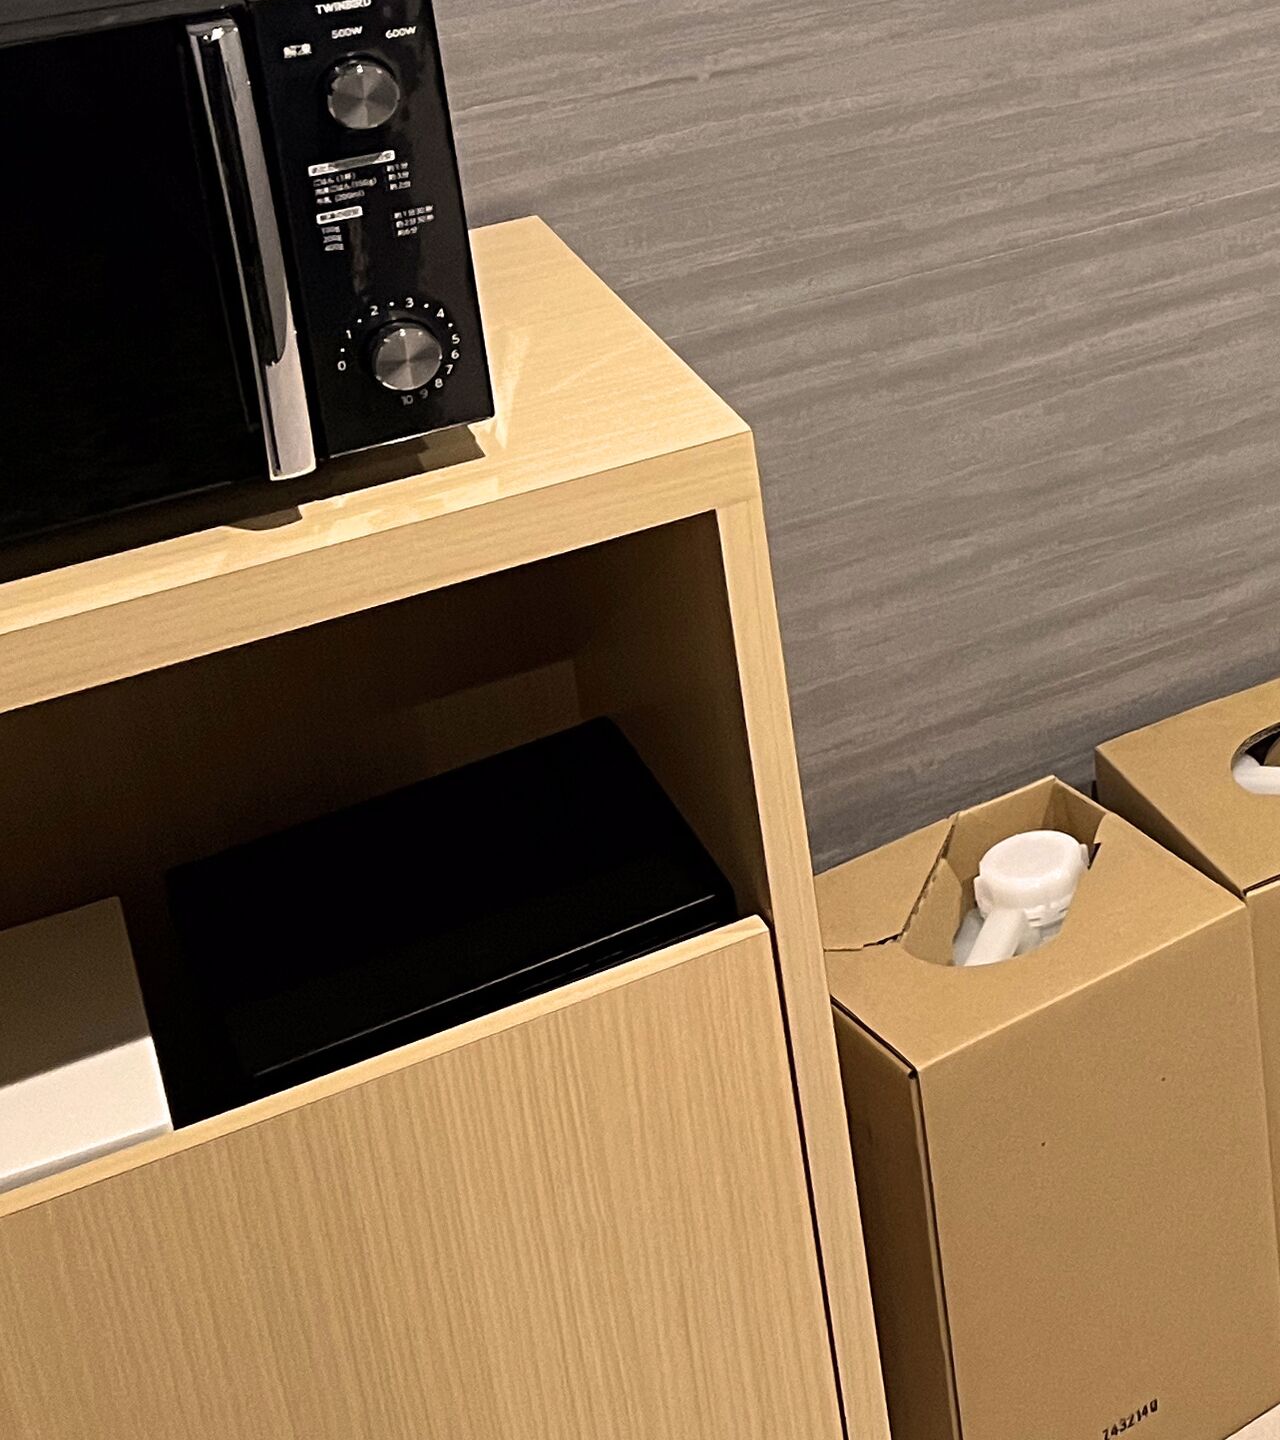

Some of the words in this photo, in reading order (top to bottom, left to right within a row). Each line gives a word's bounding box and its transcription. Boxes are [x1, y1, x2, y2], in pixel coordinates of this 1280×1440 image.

[331, 26, 363, 39] 500W
[385, 26, 417, 39] 600W
[405, 297, 414, 308] 3
[370, 305, 379, 316] 2
[436, 308, 445, 318] 4
[346, 329, 352, 339] 1
[451, 334, 460, 344] 5
[451, 349, 460, 359] 6
[337, 360, 347, 371] 0
[445, 364, 454, 375] 7
[435, 378, 443, 388] 8
[419, 389, 429, 399] 9
[401, 394, 413, 406] 10
